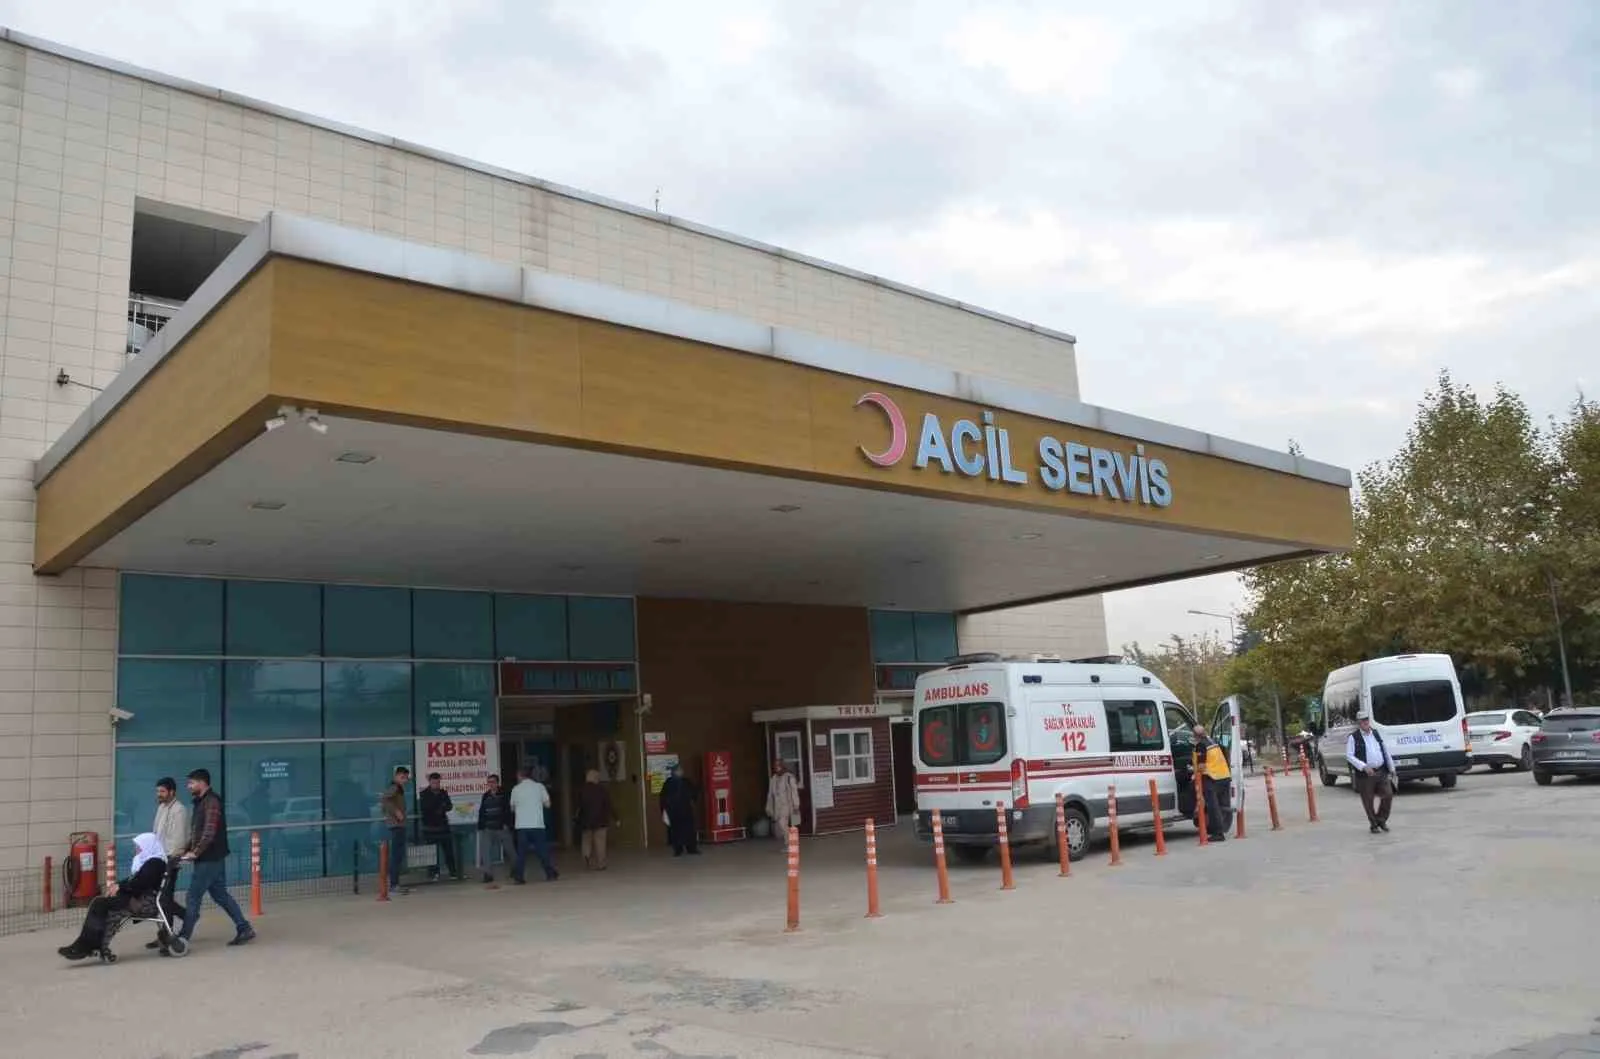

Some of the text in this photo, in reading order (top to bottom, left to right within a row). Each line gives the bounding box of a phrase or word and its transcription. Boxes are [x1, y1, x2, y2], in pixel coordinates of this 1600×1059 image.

[912, 410, 1173, 508] ACİL SERVİS
[924, 682, 989, 701] AMBULANS
[427, 740, 486, 758] KBRN
[1061, 732, 1087, 752] 112
[1113, 754, 1161, 768] AMBULANS
